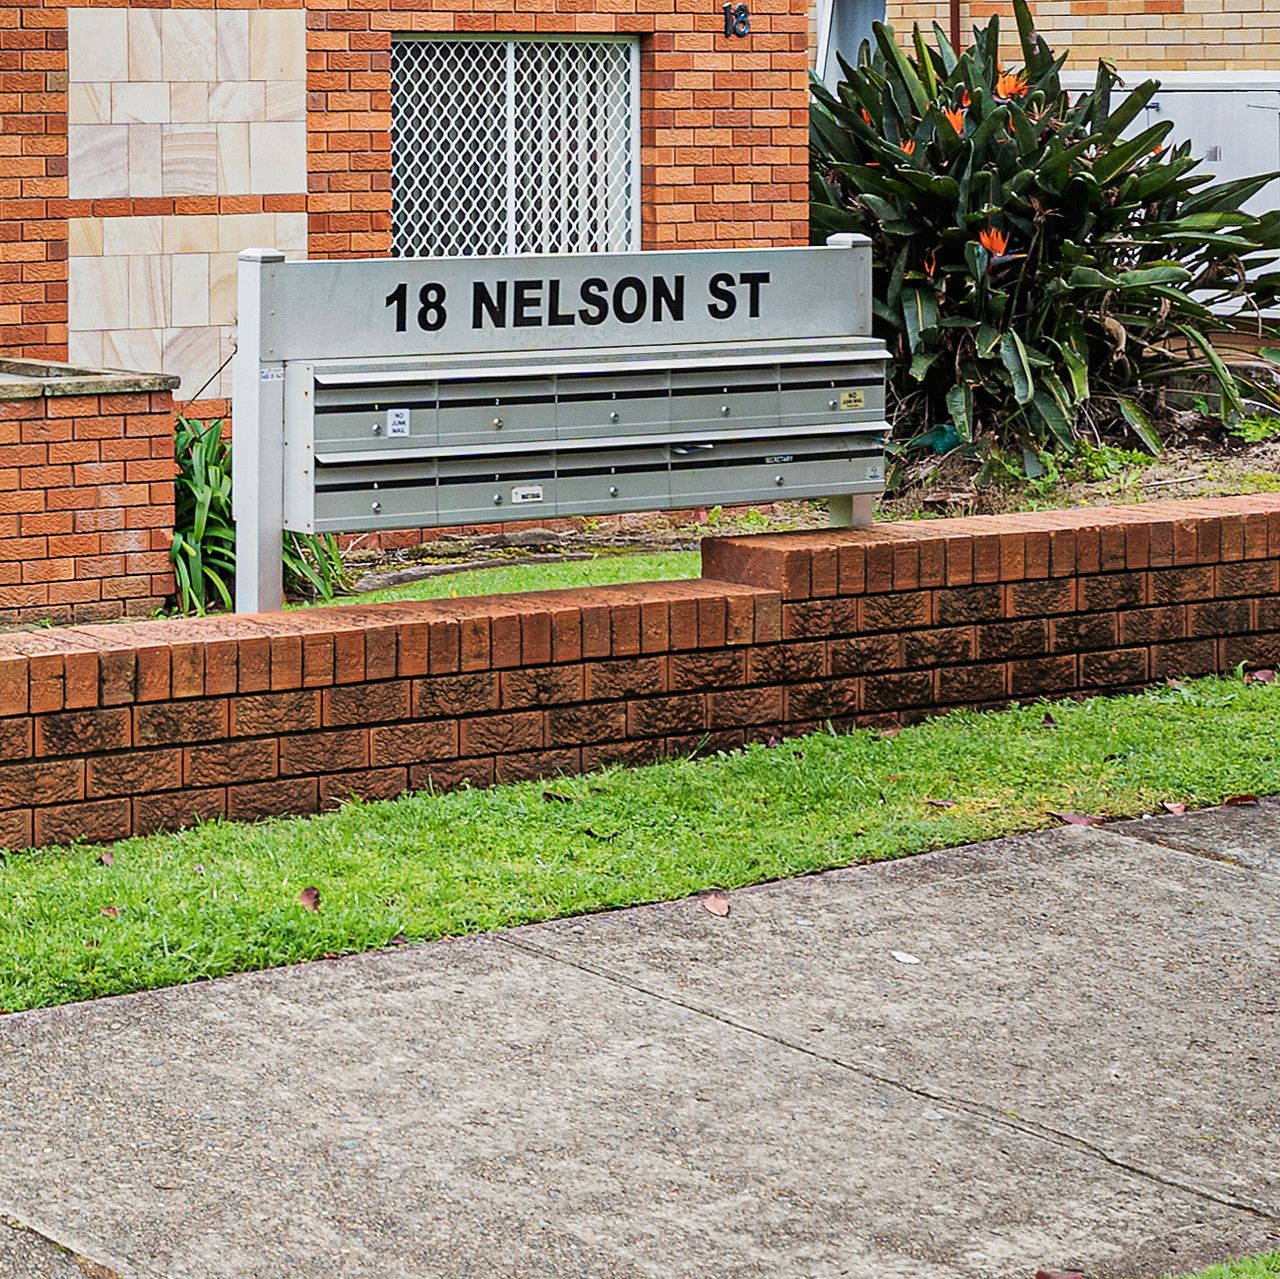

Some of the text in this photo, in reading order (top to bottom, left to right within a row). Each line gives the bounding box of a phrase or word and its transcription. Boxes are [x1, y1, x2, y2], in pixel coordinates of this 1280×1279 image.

[722, 1, 750, 38] 18
[385, 272, 771, 332] 18 NELSON ST
